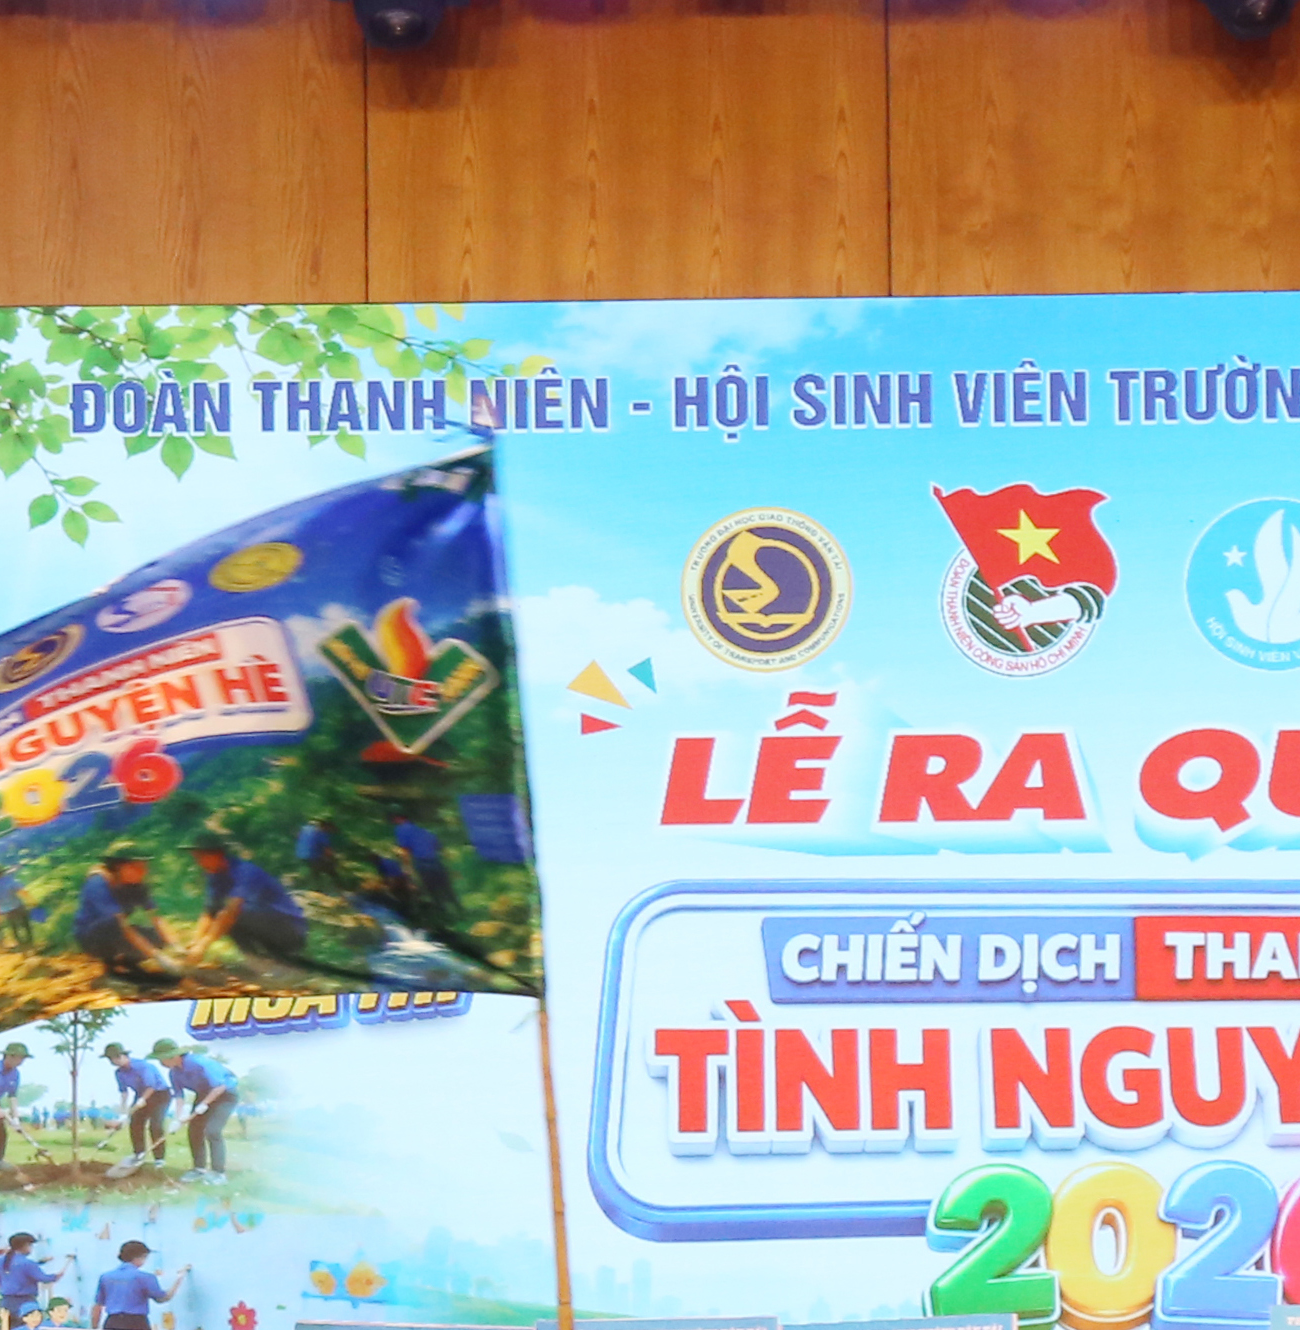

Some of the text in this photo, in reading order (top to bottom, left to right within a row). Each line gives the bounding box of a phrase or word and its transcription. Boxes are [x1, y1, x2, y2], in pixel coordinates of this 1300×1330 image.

[70, 368, 231, 434] ĐOÀN
[252, 380, 446, 432] THANH
[471, 366, 609, 432] NIÊN
[674, 364, 770, 441] HỘI
[793, 374, 932, 428] SINH
[952, 359, 1088, 426] VIÊN
[1063, 626, 1088, 651] MINH
[211, 656, 287, 704] HÈ
[660, 691, 842, 824] LỄ
[879, 732, 1087, 821] RA
[782, 912, 962, 985] CHIẾN
[978, 932, 1120, 994] DỊCH
[654, 1000, 952, 1134] TÌNH
